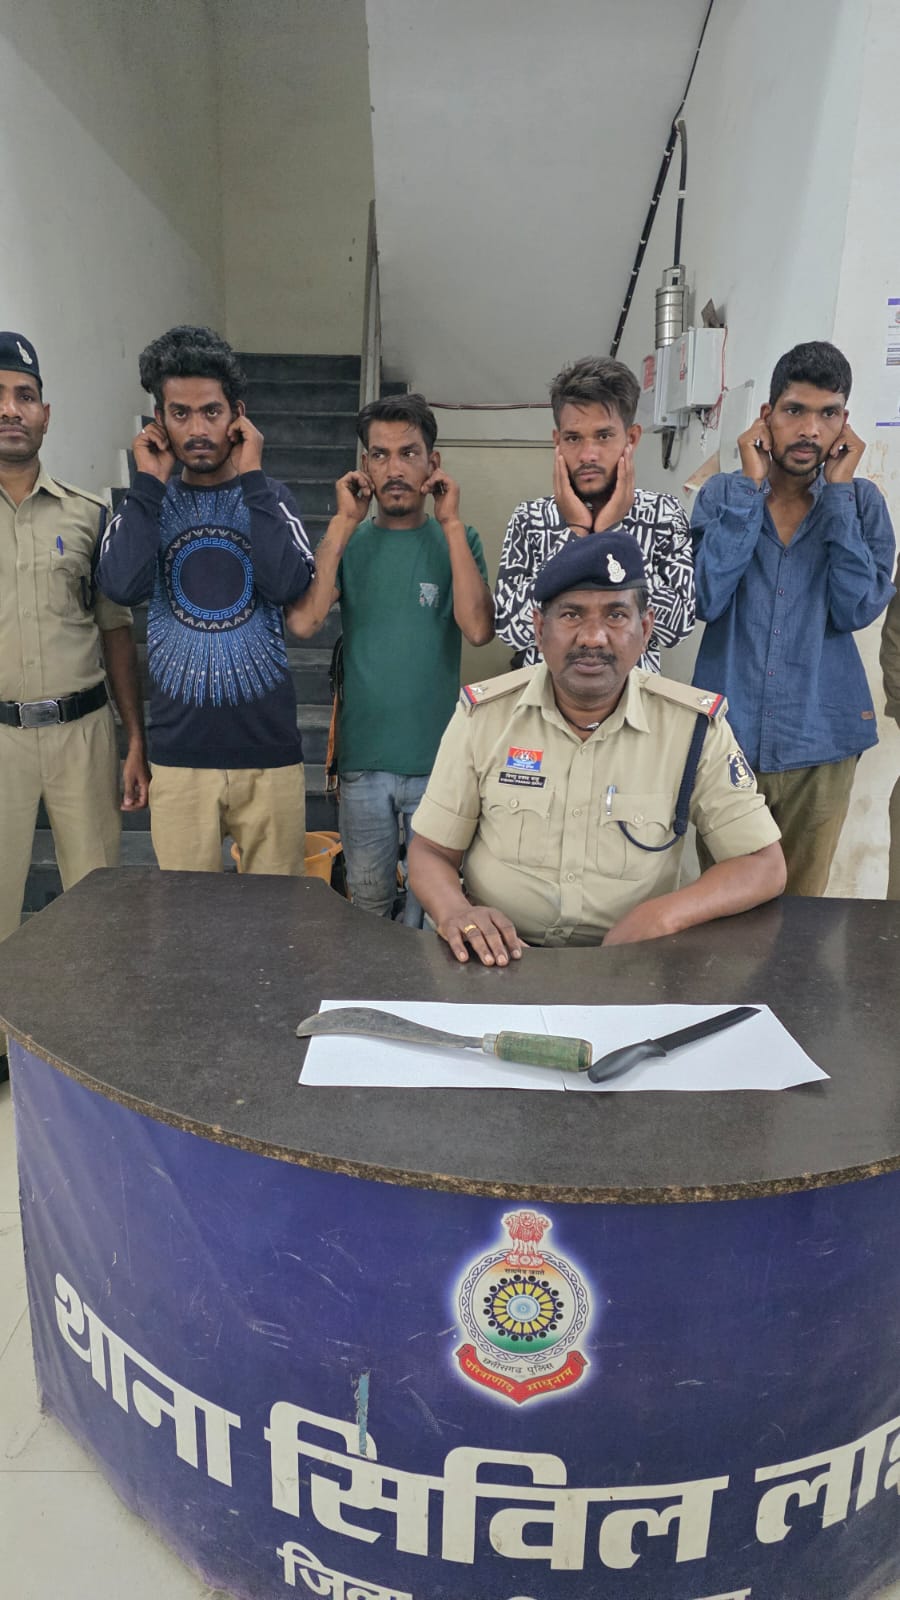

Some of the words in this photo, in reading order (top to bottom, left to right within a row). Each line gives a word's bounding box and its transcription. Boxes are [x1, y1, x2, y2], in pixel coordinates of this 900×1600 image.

[54, 1273, 241, 1487] थाना
[264, 1401, 730, 1570] सिविल
[527, 1362, 554, 1376] पुलिस
